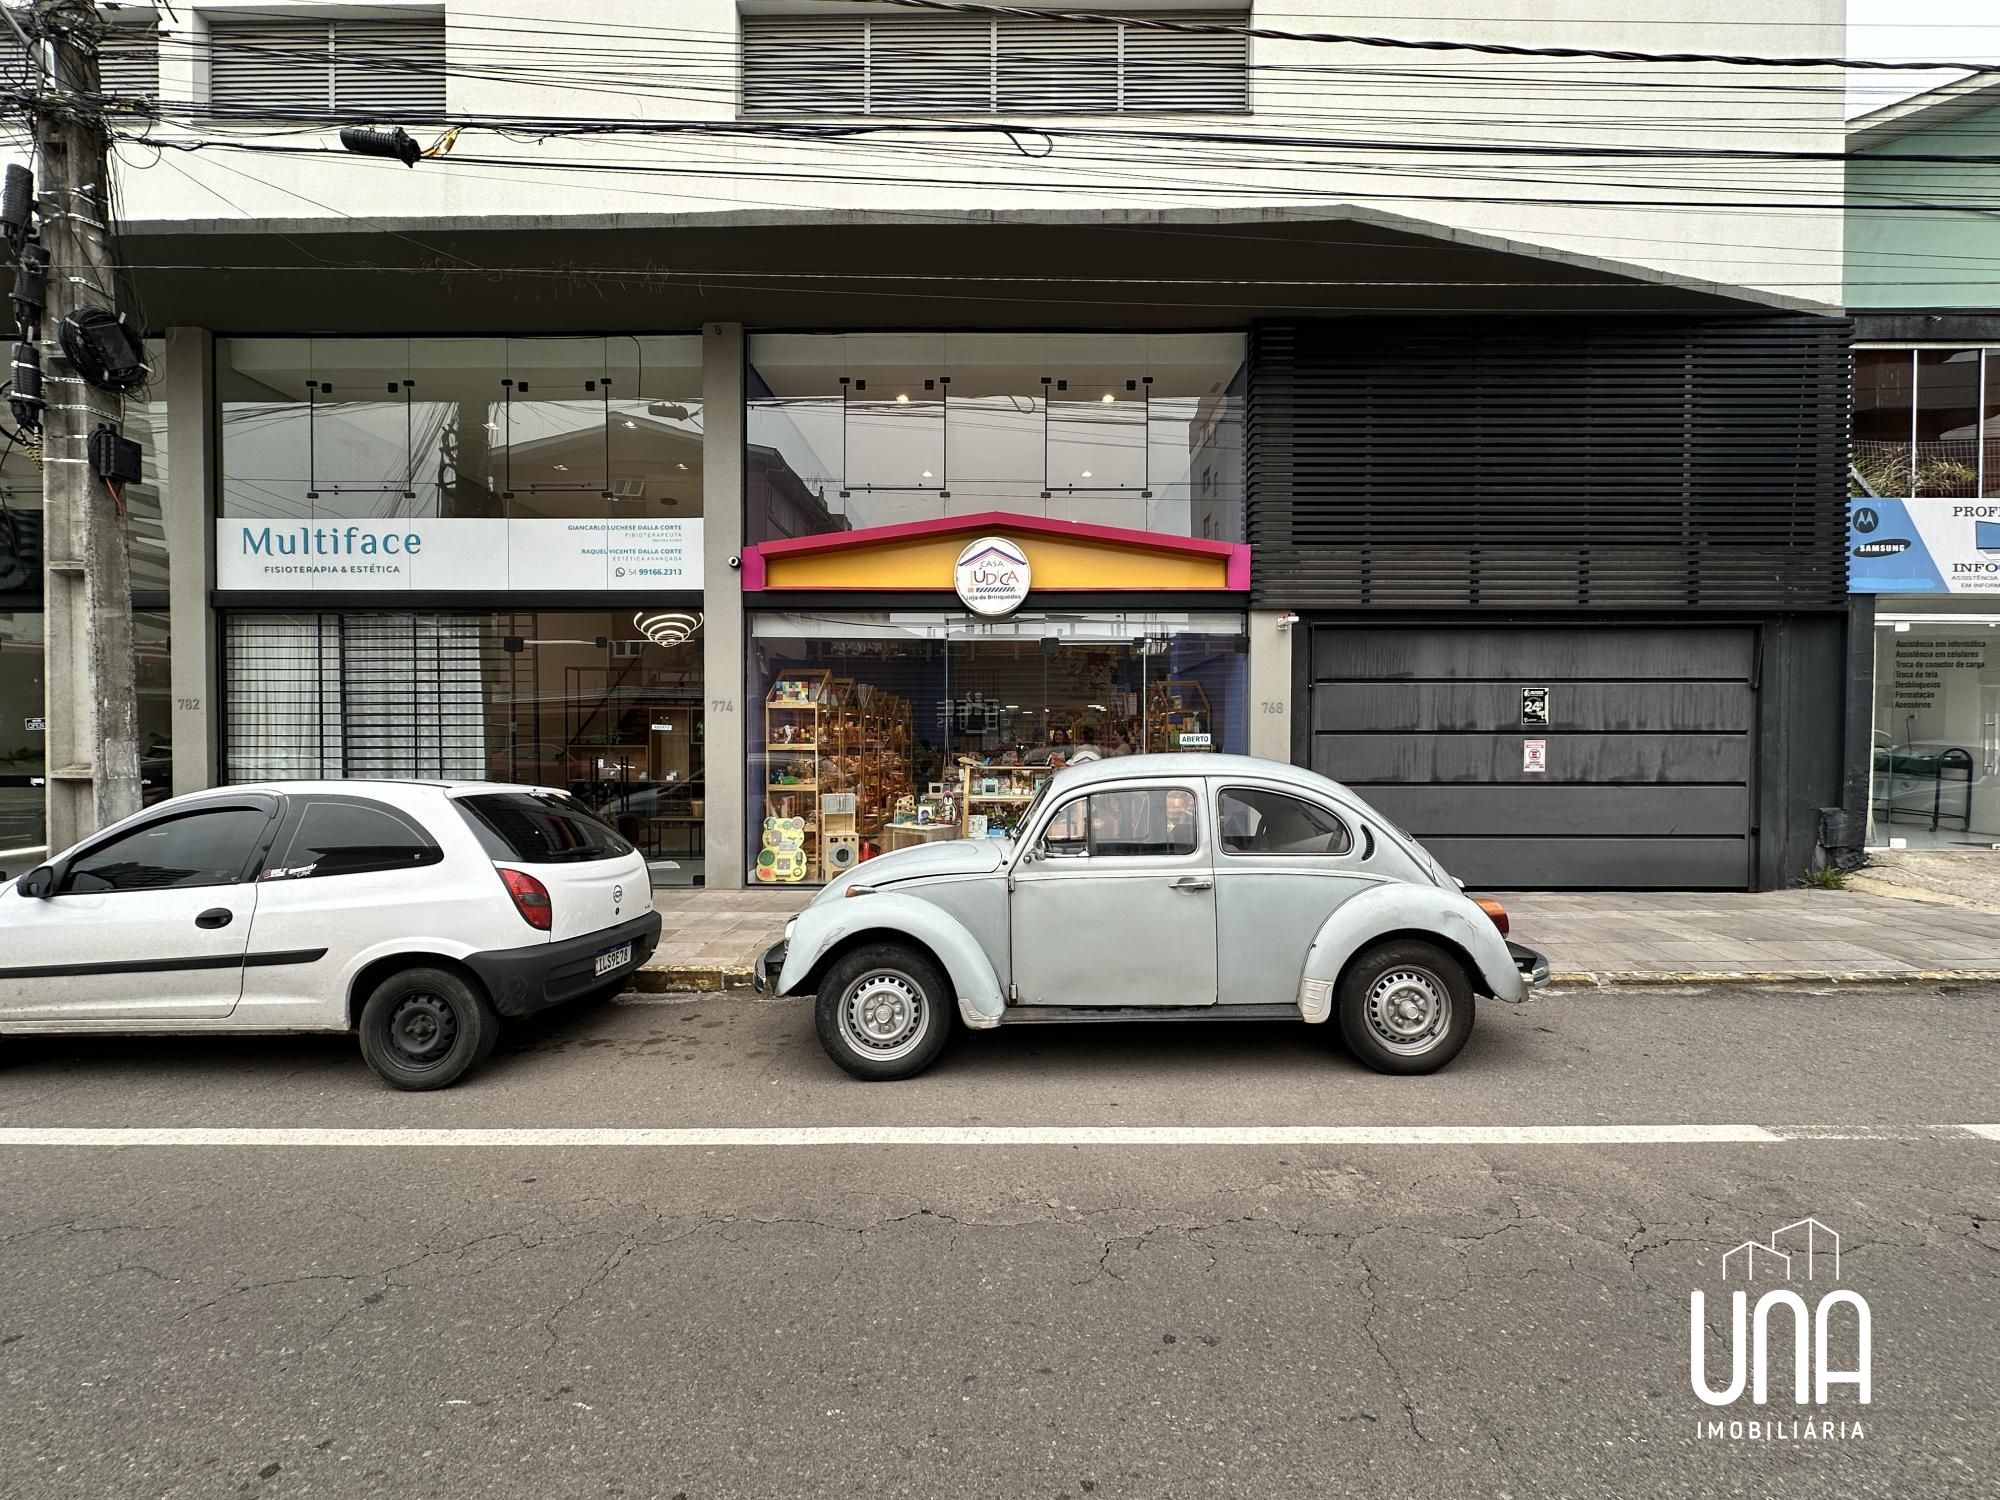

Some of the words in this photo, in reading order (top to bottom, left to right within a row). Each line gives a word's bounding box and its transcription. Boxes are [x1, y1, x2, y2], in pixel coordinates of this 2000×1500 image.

[1952, 506, 2000, 517] PROF
[242, 526, 421, 556] Multiface
[1859, 544, 1905, 552] SAMSUNG
[264, 565, 338, 573] FISIOTERAPIA
[340, 565, 347, 573] &
[350, 563, 401, 573] ESTÉTICA
[980, 560, 1004, 568] CASA
[628, 568, 637, 576] 54
[638, 568, 682, 576] 99166.2313
[1965, 661, 1985, 669] carga
[178, 698, 200, 710] 782
[711, 700, 733, 712] 774
[1261, 701, 1284, 714] 768
[1182, 735, 1209, 743] ABERTO
